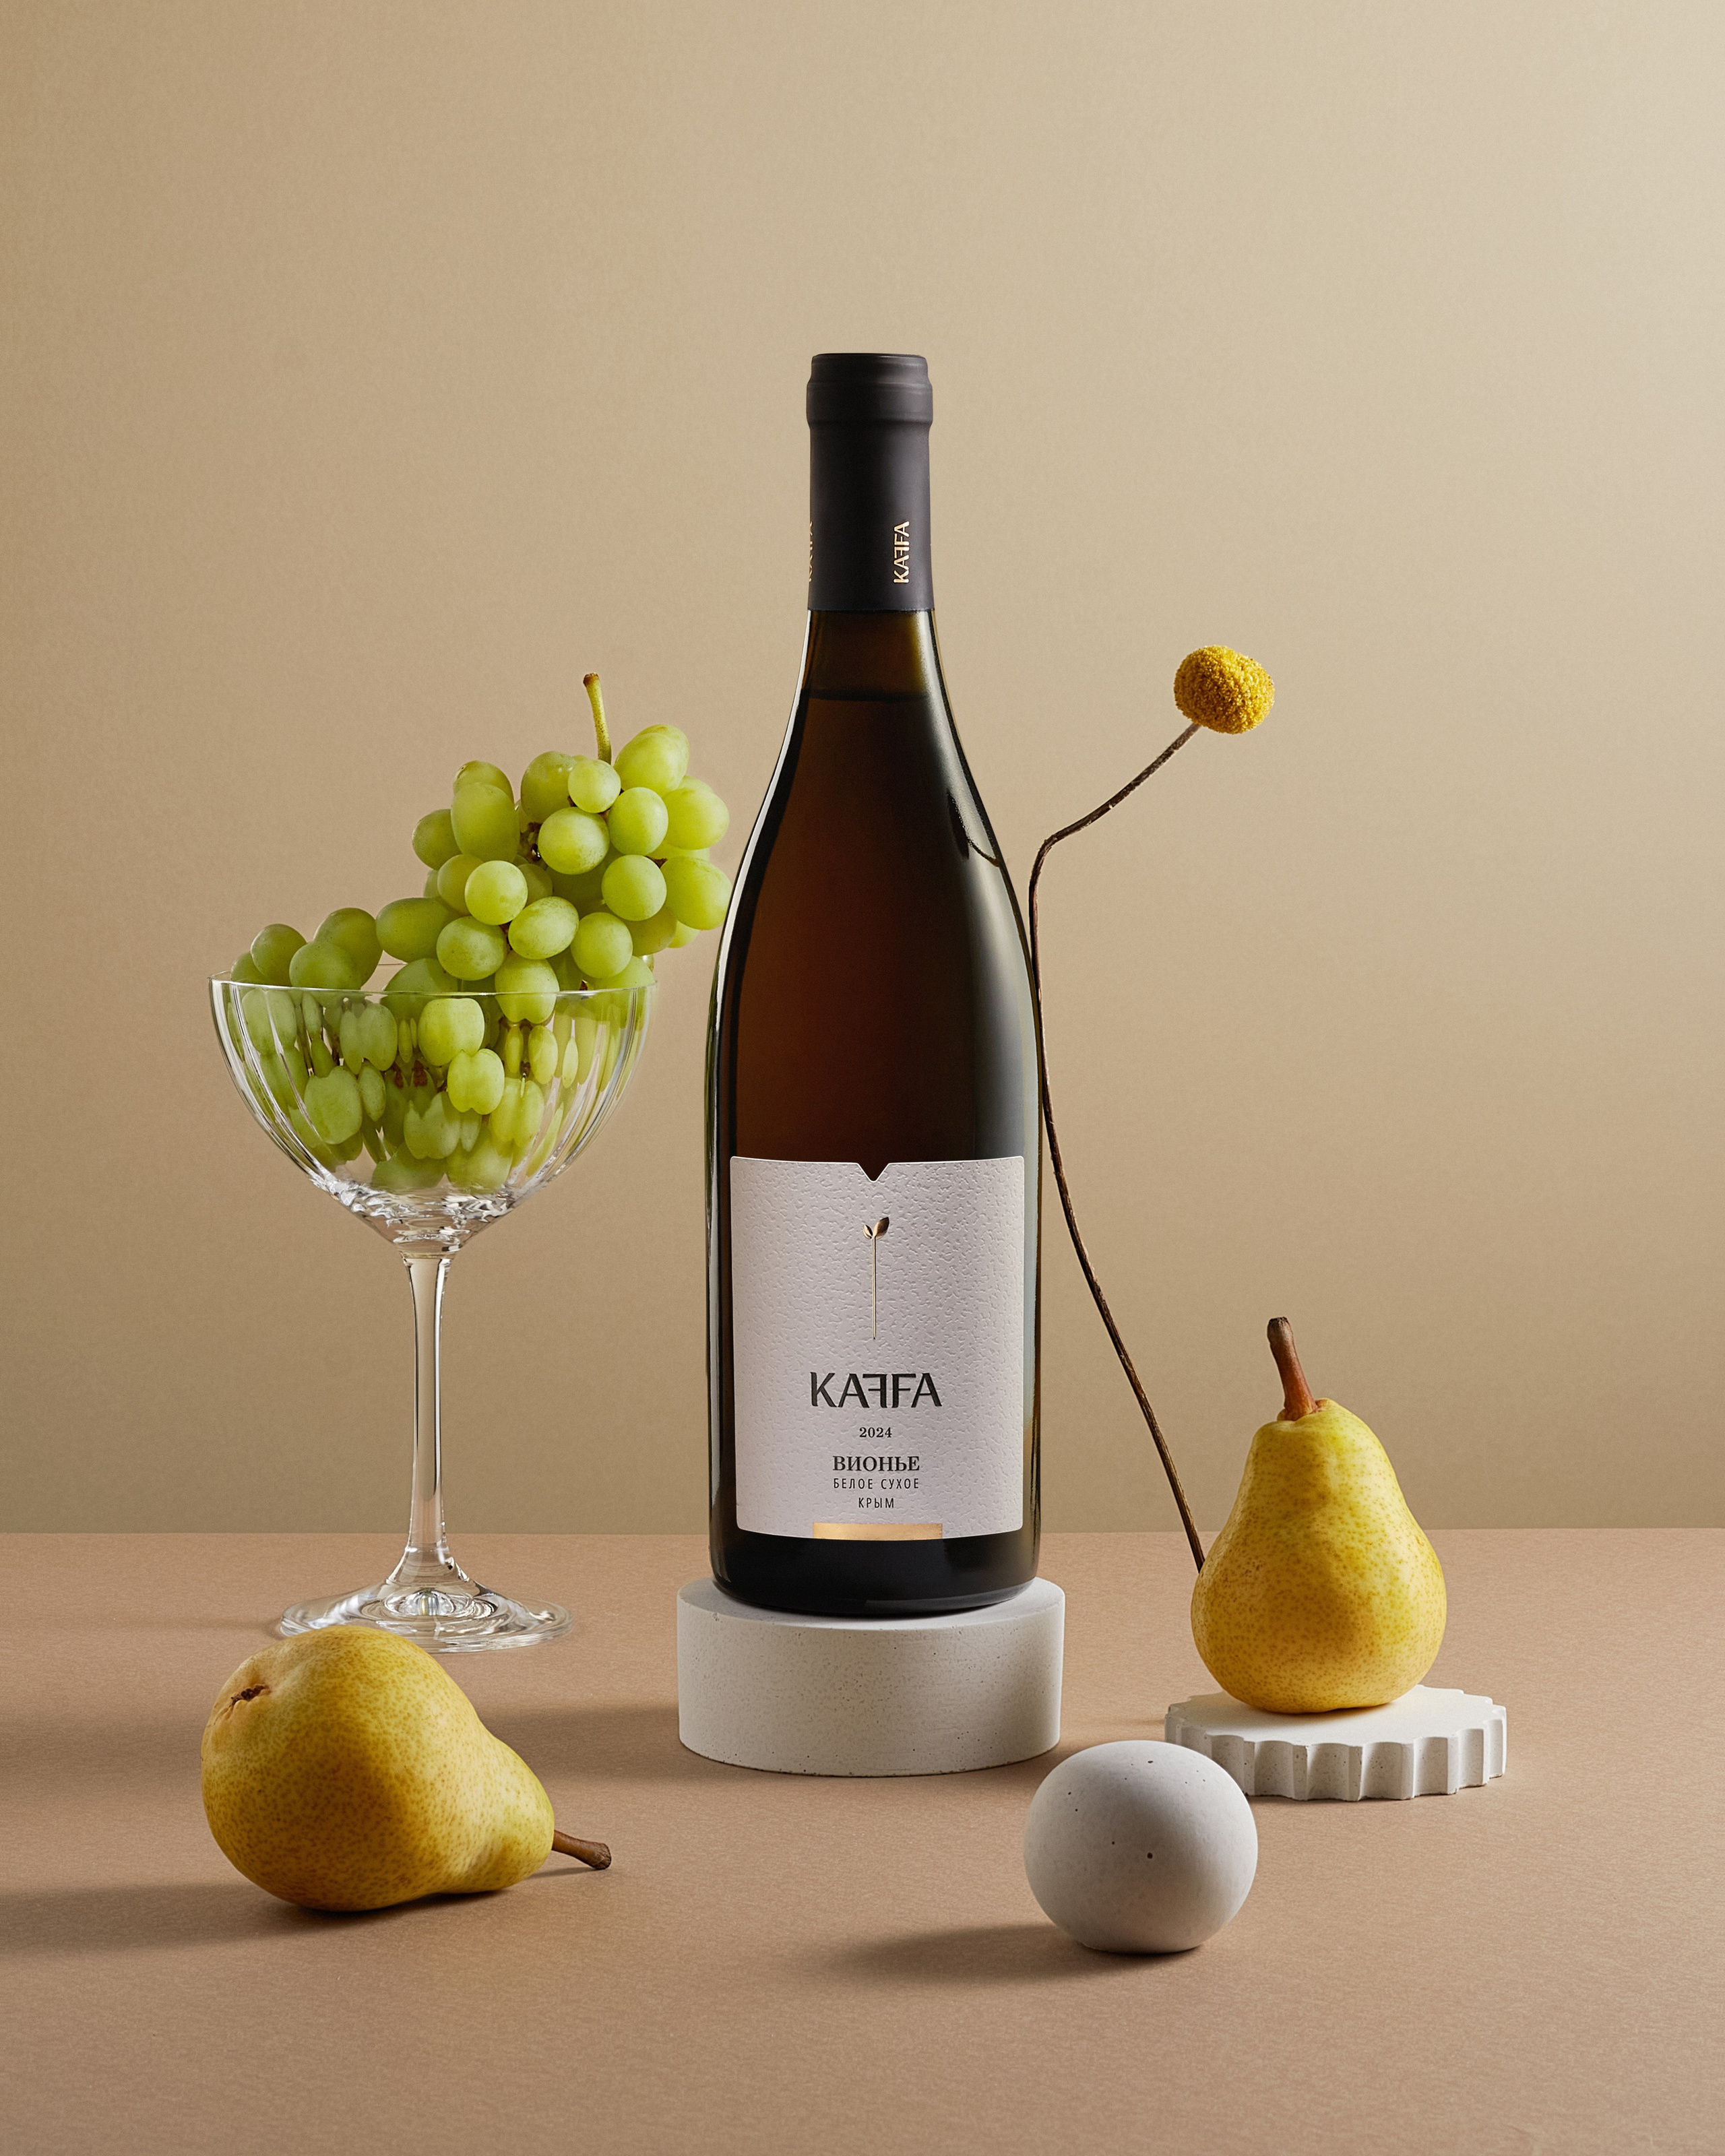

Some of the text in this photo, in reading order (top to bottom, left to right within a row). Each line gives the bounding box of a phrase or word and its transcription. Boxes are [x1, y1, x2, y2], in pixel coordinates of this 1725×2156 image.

[893, 521, 910, 583] KAFFA
[810, 1372, 942, 1408] KAFFA
[859, 1427, 893, 1438] 2024
[832, 1455, 920, 1471] ВИОНЬЕ
[834, 1478, 919, 1490] БЕЛОЕ СУХОЕ
[858, 1498, 895, 1509] КРЫМ
